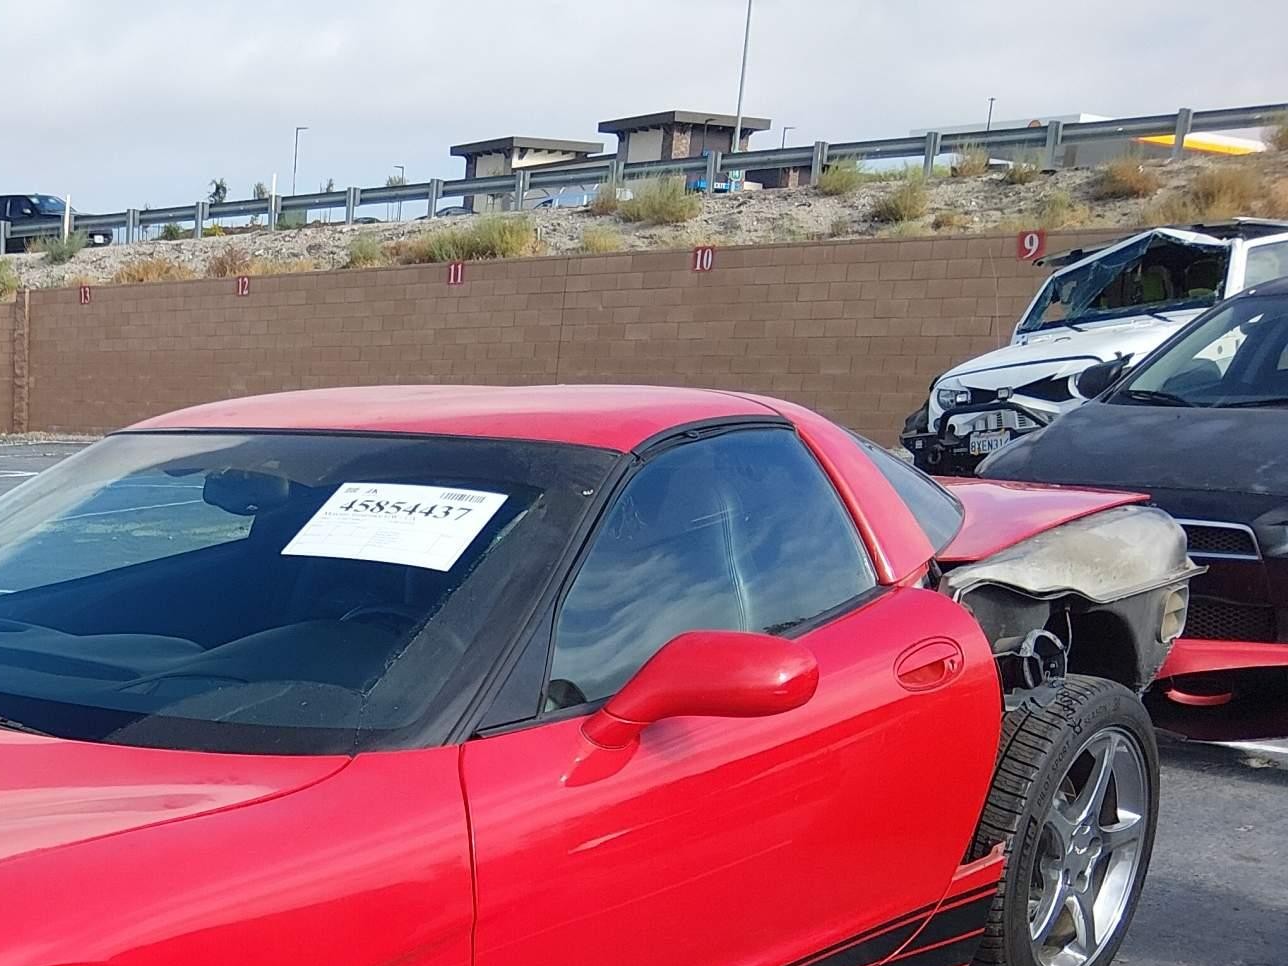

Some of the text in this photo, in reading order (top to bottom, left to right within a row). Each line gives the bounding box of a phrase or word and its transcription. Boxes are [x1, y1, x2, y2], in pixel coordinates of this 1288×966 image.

[1024, 233, 1039, 258] 9
[695, 249, 712, 271] 10
[449, 264, 462, 284] 11
[80, 287, 90, 304] 13
[237, 277, 249, 296] 12
[339, 499, 473, 521] 45854437
